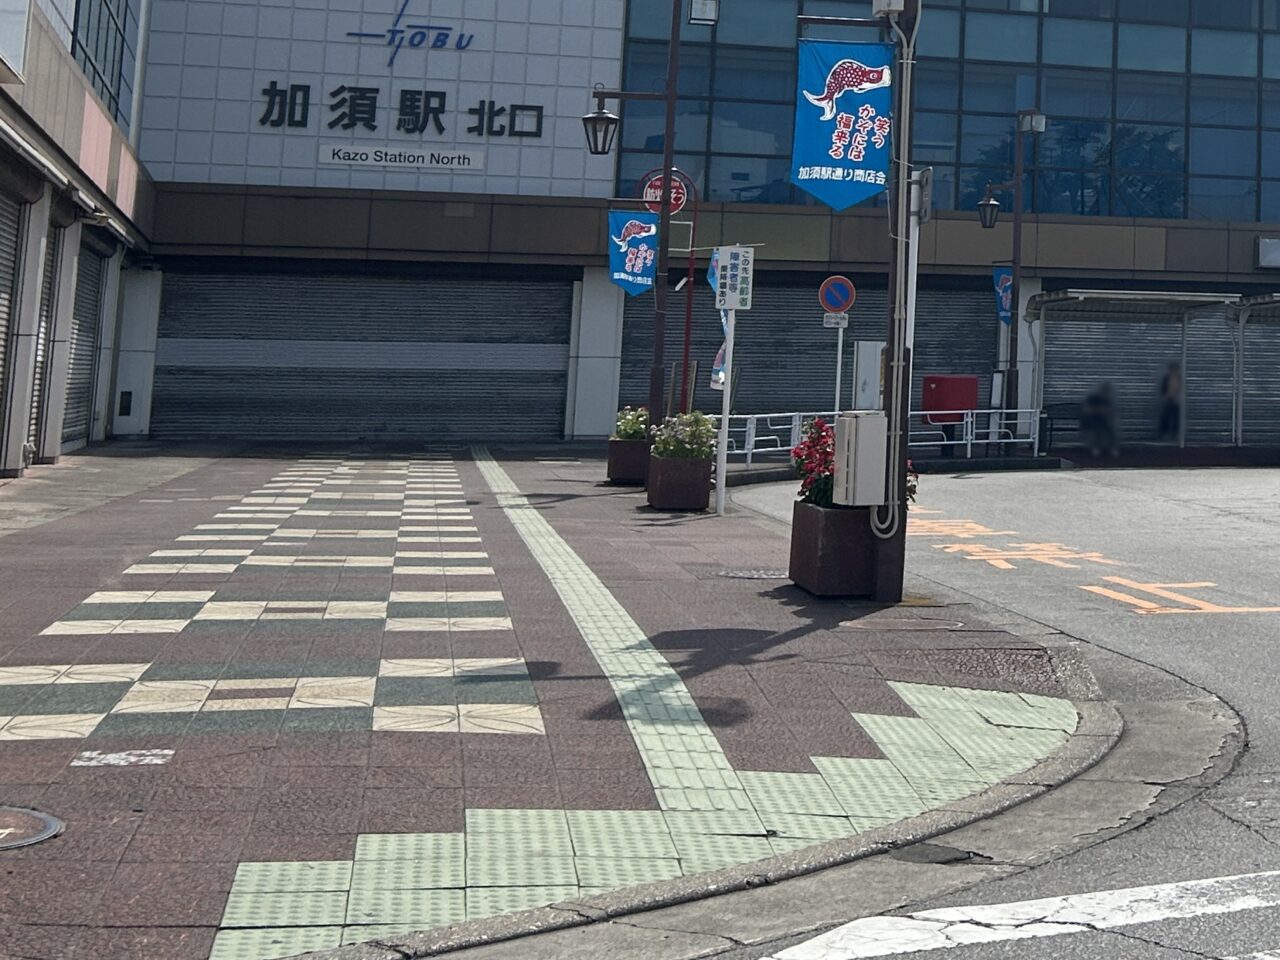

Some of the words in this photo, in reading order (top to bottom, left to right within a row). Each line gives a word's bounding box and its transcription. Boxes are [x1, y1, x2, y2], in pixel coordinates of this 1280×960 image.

[259, 81, 447, 136] 加須駅
[467, 100, 544, 139] 北口
[829, 112, 855, 159] 福来る
[848, 104, 876, 161] かぞには
[872, 115, 891, 149] 笑う
[331, 148, 369, 162] Kazo
[373, 150, 425, 164] Station
[430, 152, 471, 167] North
[798, 166, 887, 185] 加須駅通り商店会
[646, 187, 685, 204] 防火そう
